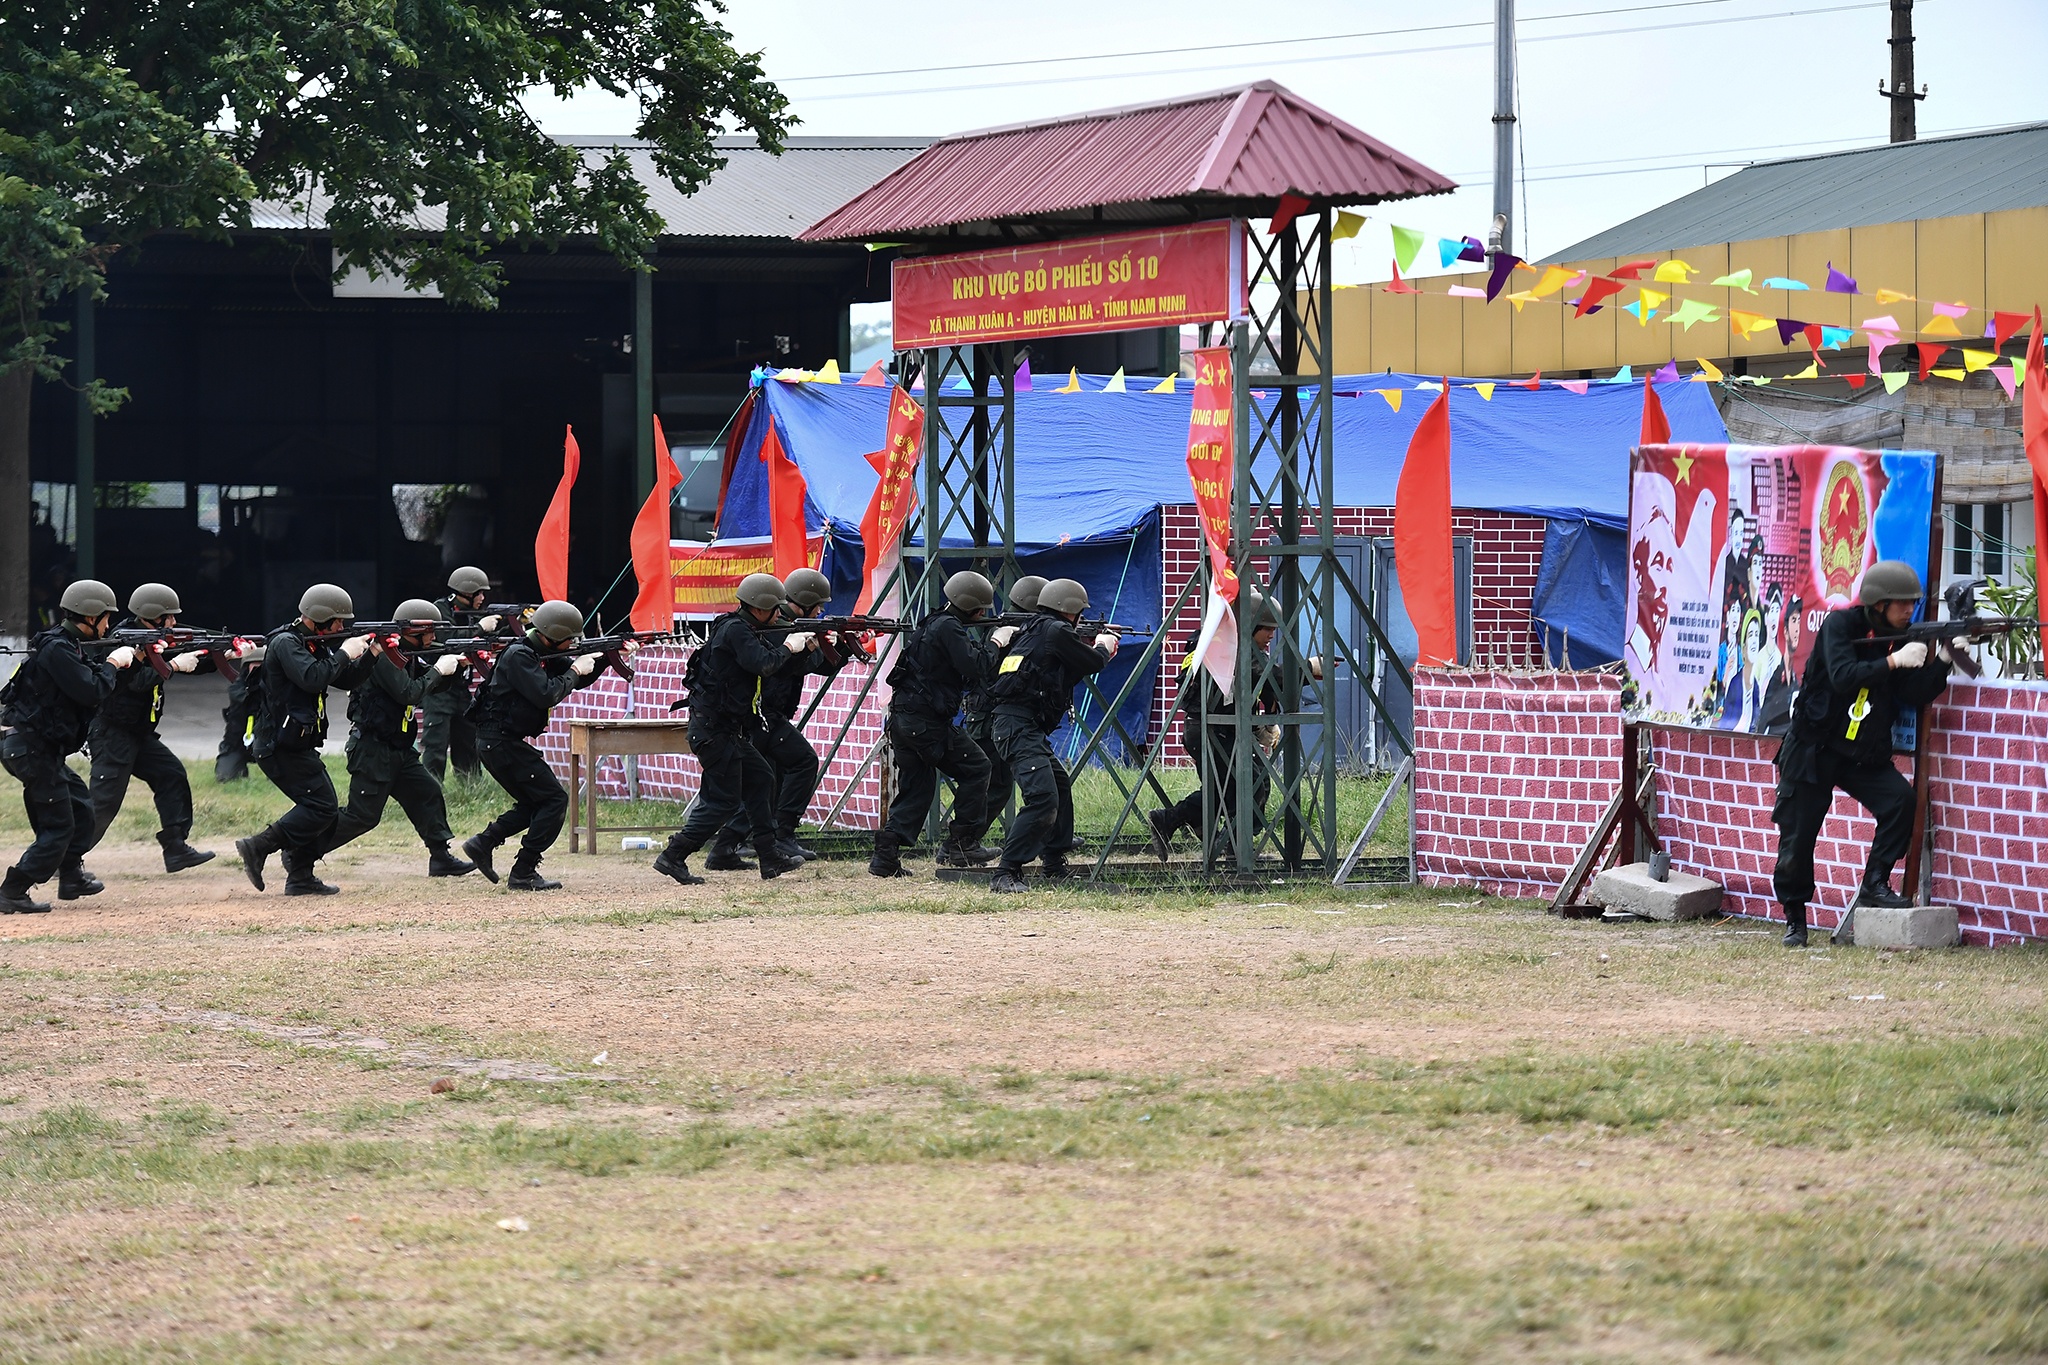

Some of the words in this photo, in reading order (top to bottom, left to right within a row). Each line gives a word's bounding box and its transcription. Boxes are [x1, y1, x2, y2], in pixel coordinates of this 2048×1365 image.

[952, 275, 984, 300] KHU
[988, 270, 1020, 300] VỰC
[1024, 259, 1046, 292] BỎ
[1052, 254, 1103, 290] PHIẾU
[1108, 250, 1132, 284] SỐ
[1138, 256, 1158, 280] 10
[930, 316, 942, 334] XÃ
[944, 316, 976, 333] THANH
[978, 310, 1004, 330] XUÂN
[1006, 312, 1014, 328] A
[1024, 305, 1056, 328] HUYỆN
[1059, 299, 1076, 322] HẢI
[1080, 300, 1094, 320] HÀ
[1103, 296, 1128, 318] TỈNH
[1130, 297, 1156, 316] NAM
